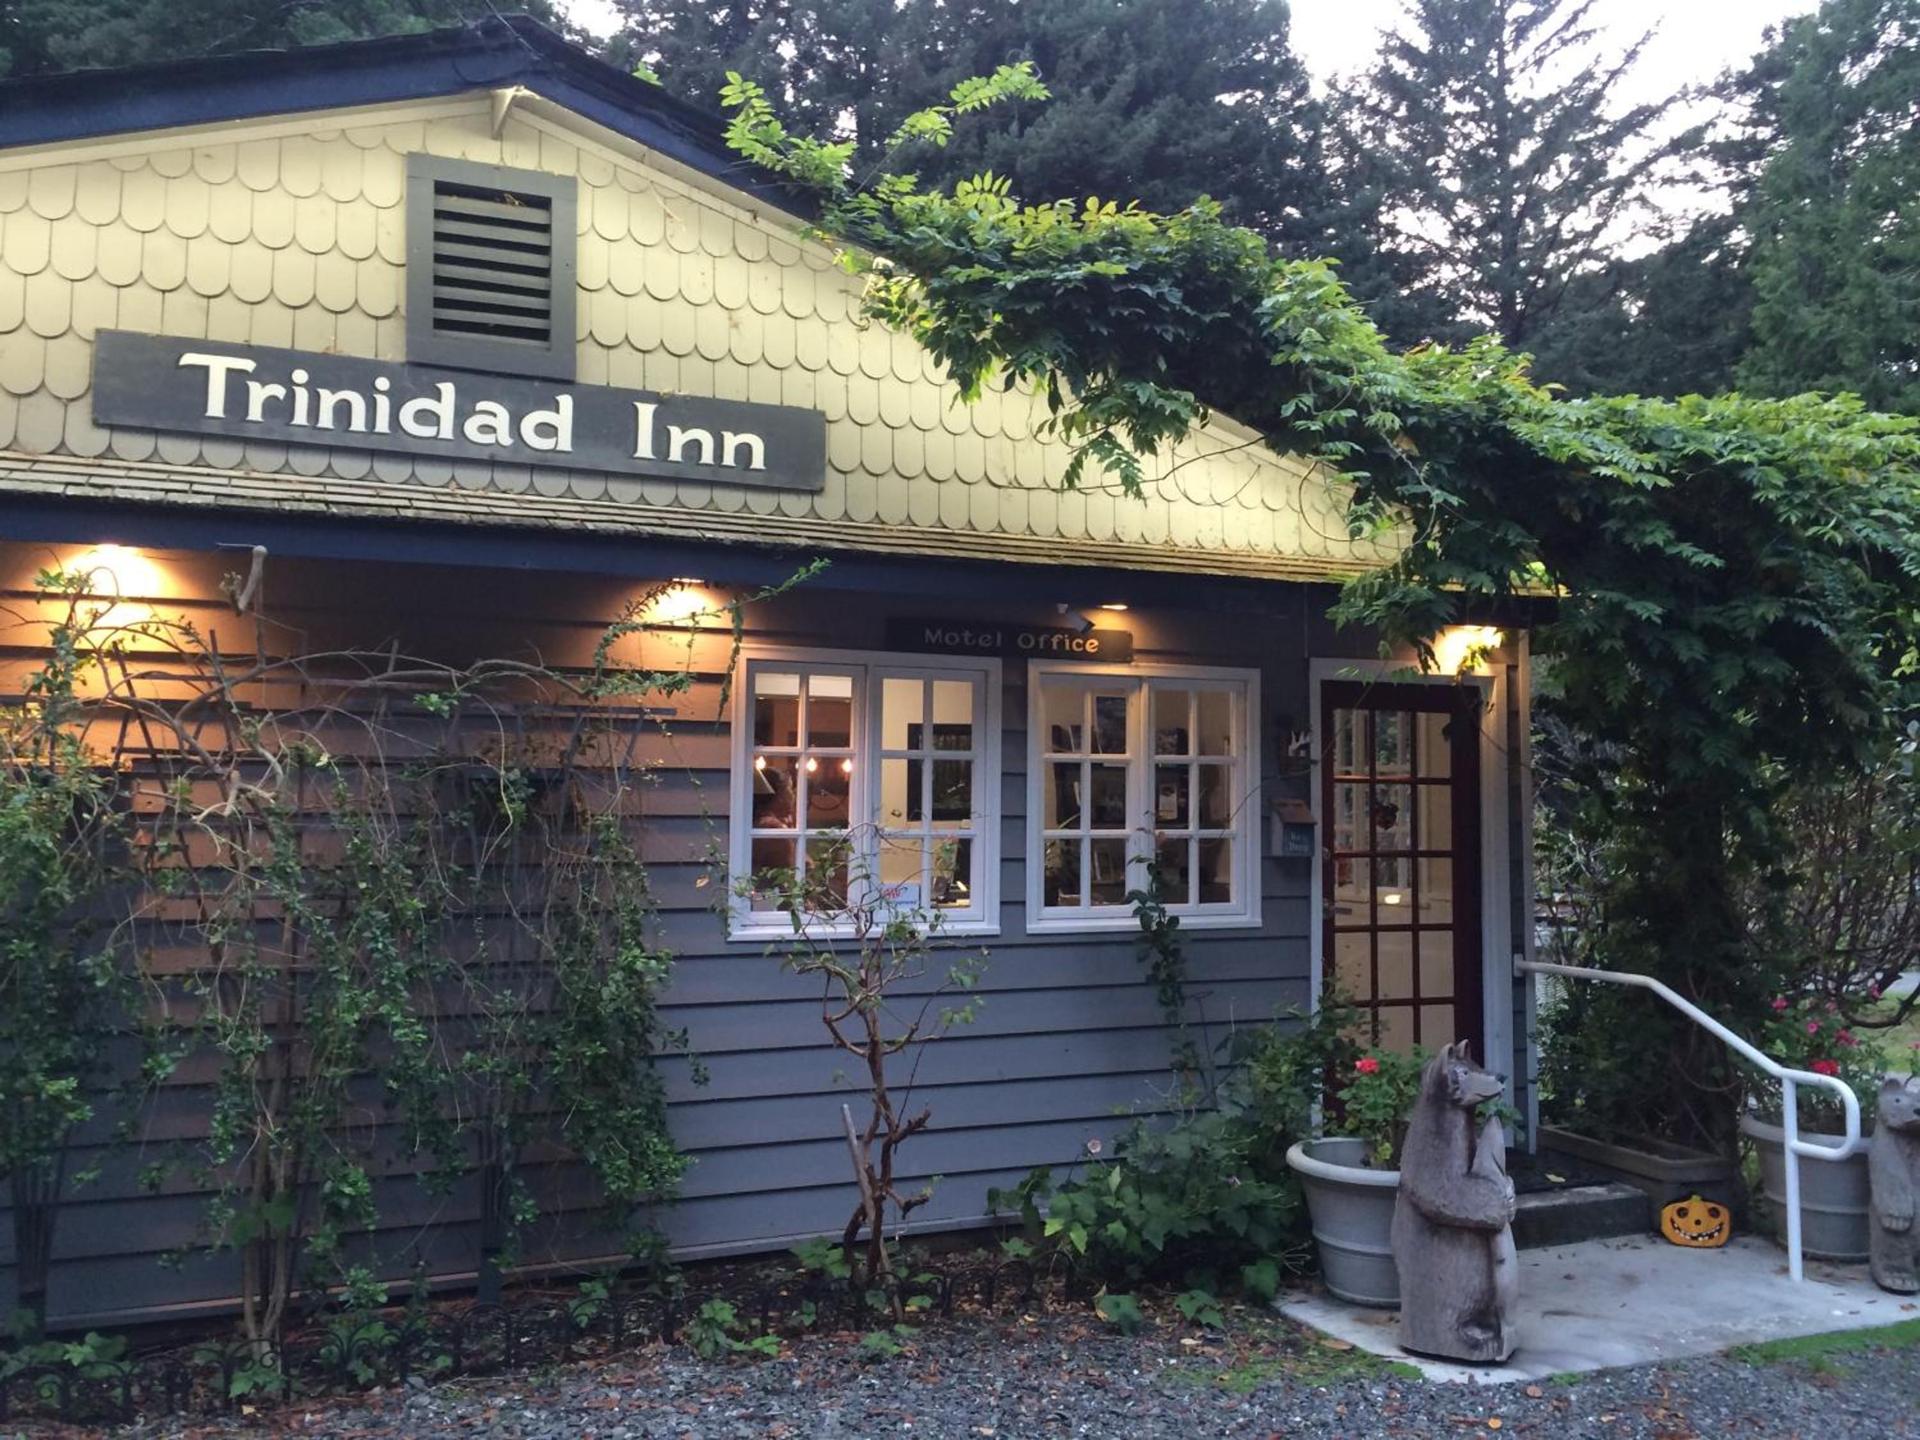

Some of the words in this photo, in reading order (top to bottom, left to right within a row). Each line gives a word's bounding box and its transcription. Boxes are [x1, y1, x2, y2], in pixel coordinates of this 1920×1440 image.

[178, 352, 574, 452] Trinidad
[632, 401, 767, 470] Inn
[924, 627, 1001, 648] Motel
[1018, 632, 1099, 653] Office
